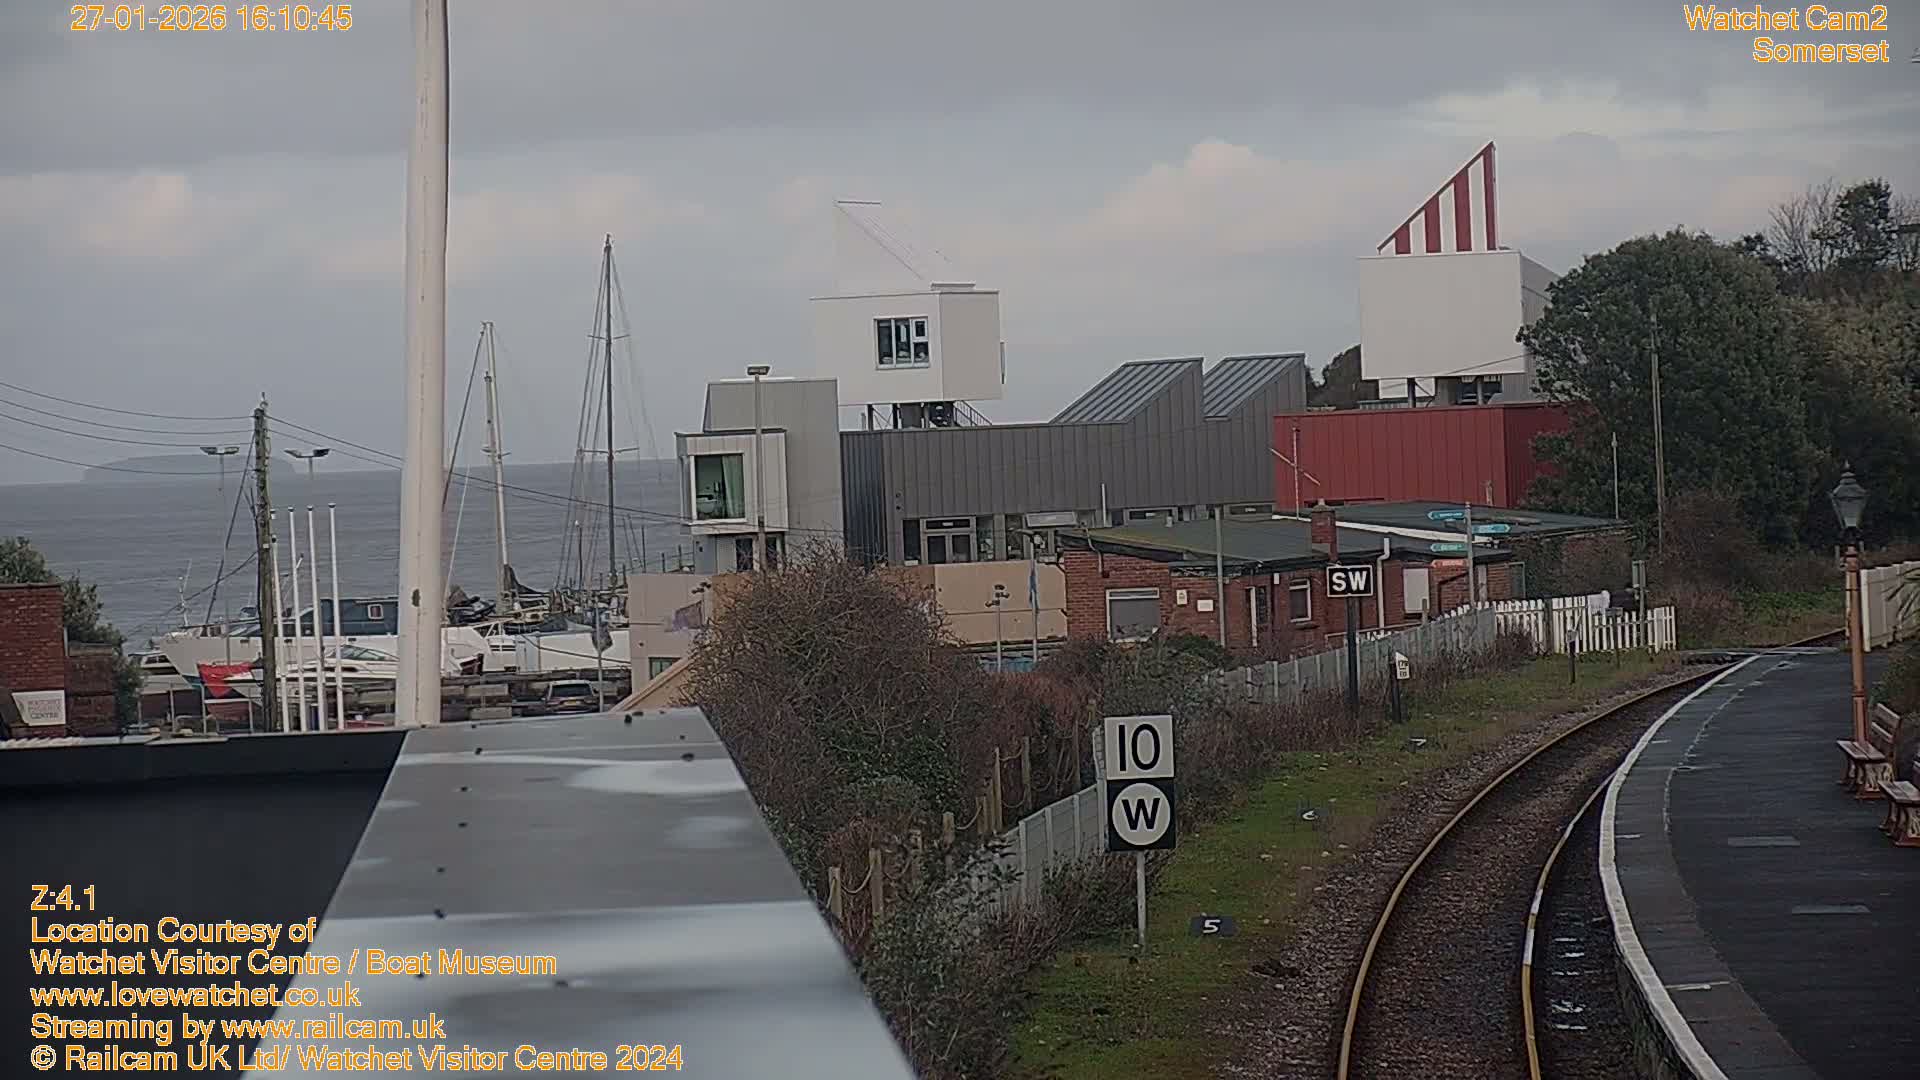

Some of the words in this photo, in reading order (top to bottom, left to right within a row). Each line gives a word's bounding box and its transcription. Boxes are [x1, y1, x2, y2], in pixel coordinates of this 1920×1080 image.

[1332, 571, 1368, 591] SW
[1118, 723, 1161, 771] 10
[1121, 798, 1161, 831] W
[1202, 919, 1221, 933] 5
